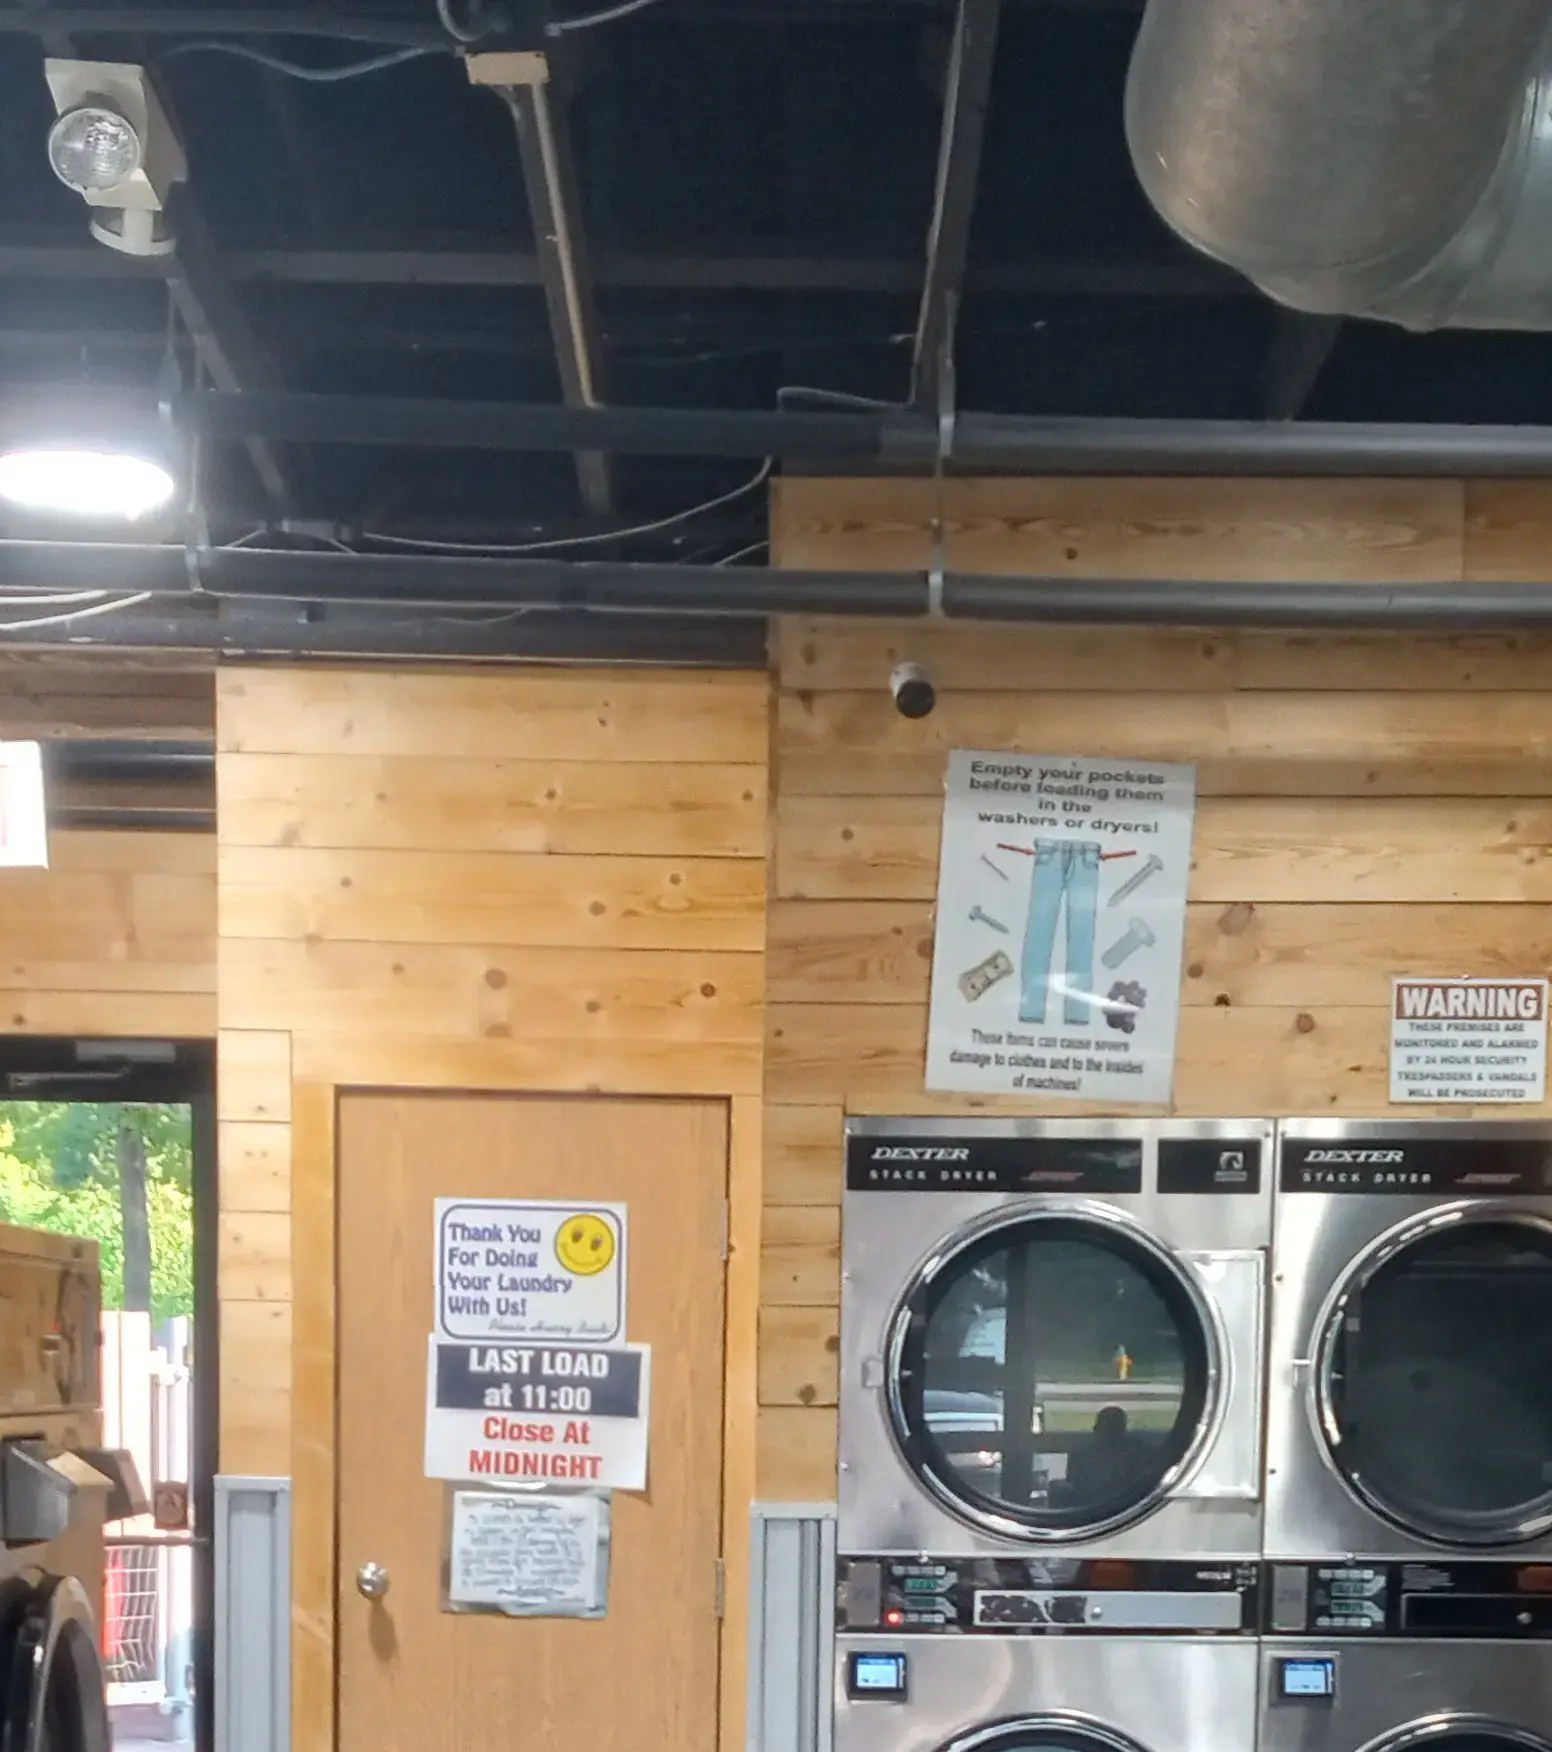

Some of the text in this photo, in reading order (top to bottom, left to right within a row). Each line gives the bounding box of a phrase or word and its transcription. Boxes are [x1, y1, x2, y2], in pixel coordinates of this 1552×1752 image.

[971, 761, 1164, 785] Empty your pockets
[969, 778, 1164, 800] before loading them
[1039, 800, 1092, 813] in the
[978, 812, 1058, 827] washers
[1064, 818, 1083, 828] or
[1402, 986, 1538, 1018] WARNING
[871, 1146, 970, 1161] DEXTER
[1304, 1149, 1405, 1163] DEXTER
[870, 1169, 997, 1181] STACK DRYER
[1303, 1171, 1432, 1183] STACK DRYER
[448, 1222, 541, 1243] Thank You
[448, 1247, 538, 1268] For Doing
[448, 1271, 572, 1293] Your Laundry
[448, 1297, 527, 1317] With Us!
[469, 1347, 610, 1378] LAST LOAD
[484, 1383, 592, 1411] at 11:00
[484, 1416, 590, 1445] Close At
[469, 1450, 604, 1479] MIDNIGHT
